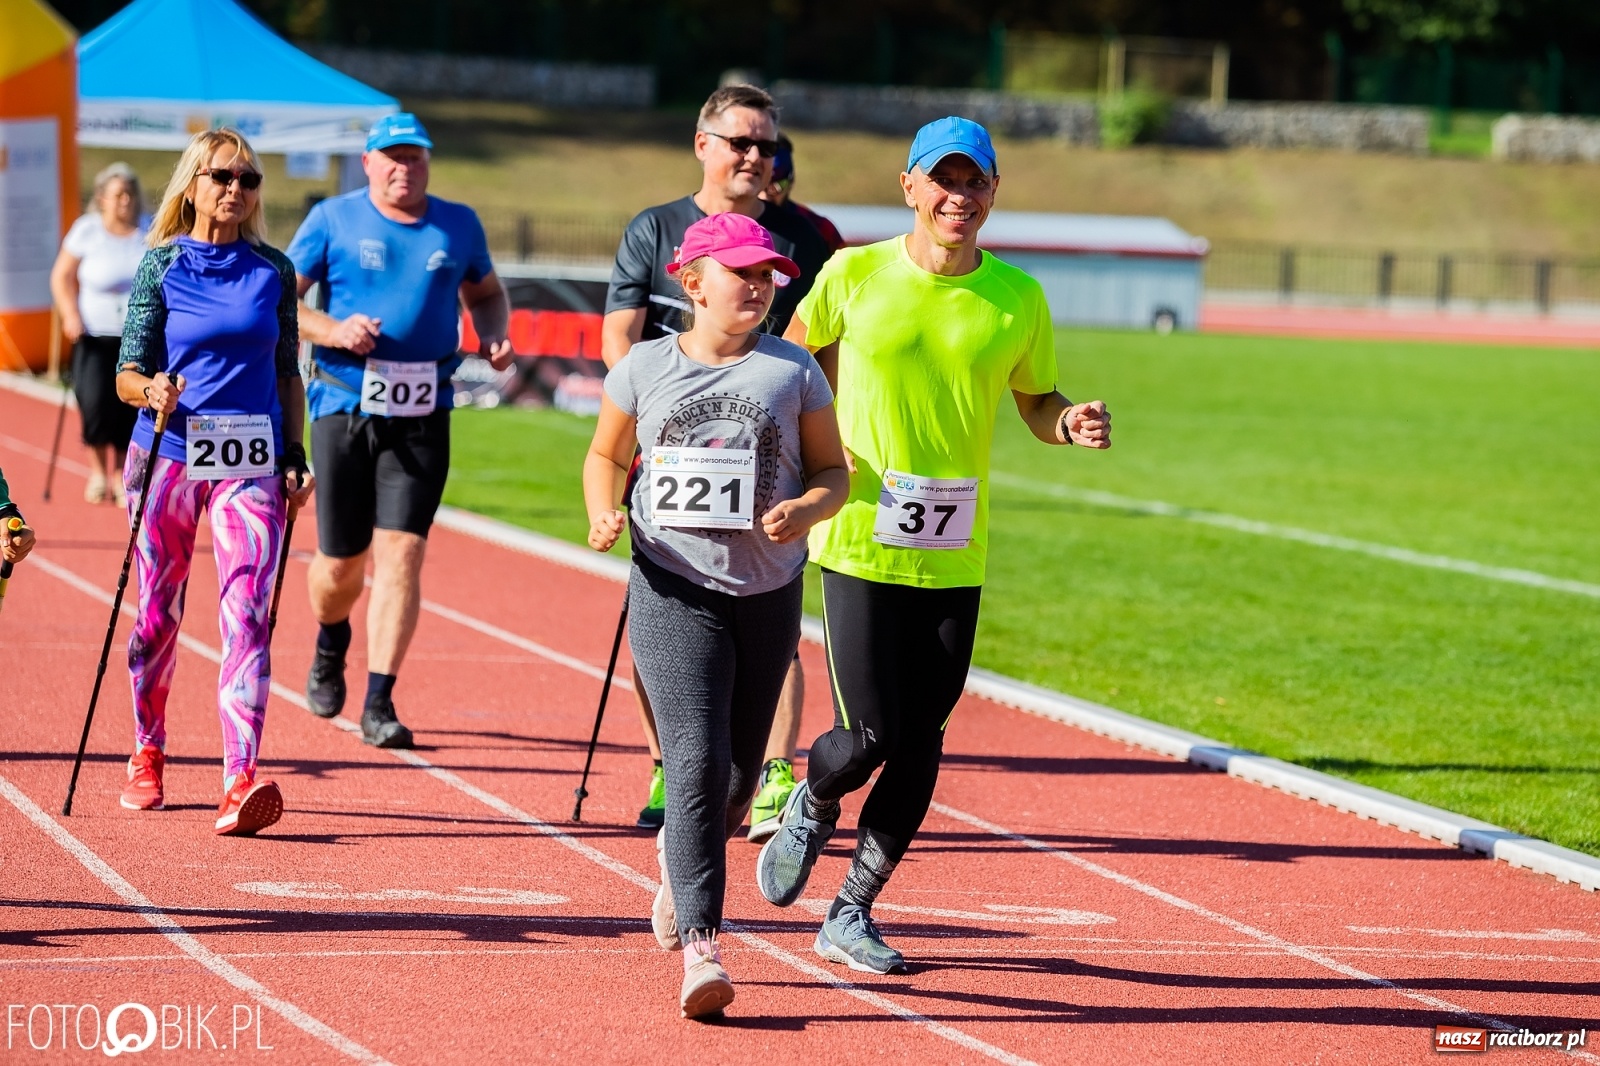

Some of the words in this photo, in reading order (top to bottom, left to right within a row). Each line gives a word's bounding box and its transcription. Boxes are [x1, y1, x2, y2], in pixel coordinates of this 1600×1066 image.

[368, 381, 432, 405] 202
[193, 437, 269, 467] 208
[672, 401, 723, 428] ROCK'N
[728, 402, 763, 422] ROLL
[759, 426, 773, 501] CONCERT
[684, 456, 751, 466] www.personalbest.pl
[656, 475, 741, 514] 221
[919, 485, 975, 493] www.personalbest.pl
[897, 501, 958, 536] 37
